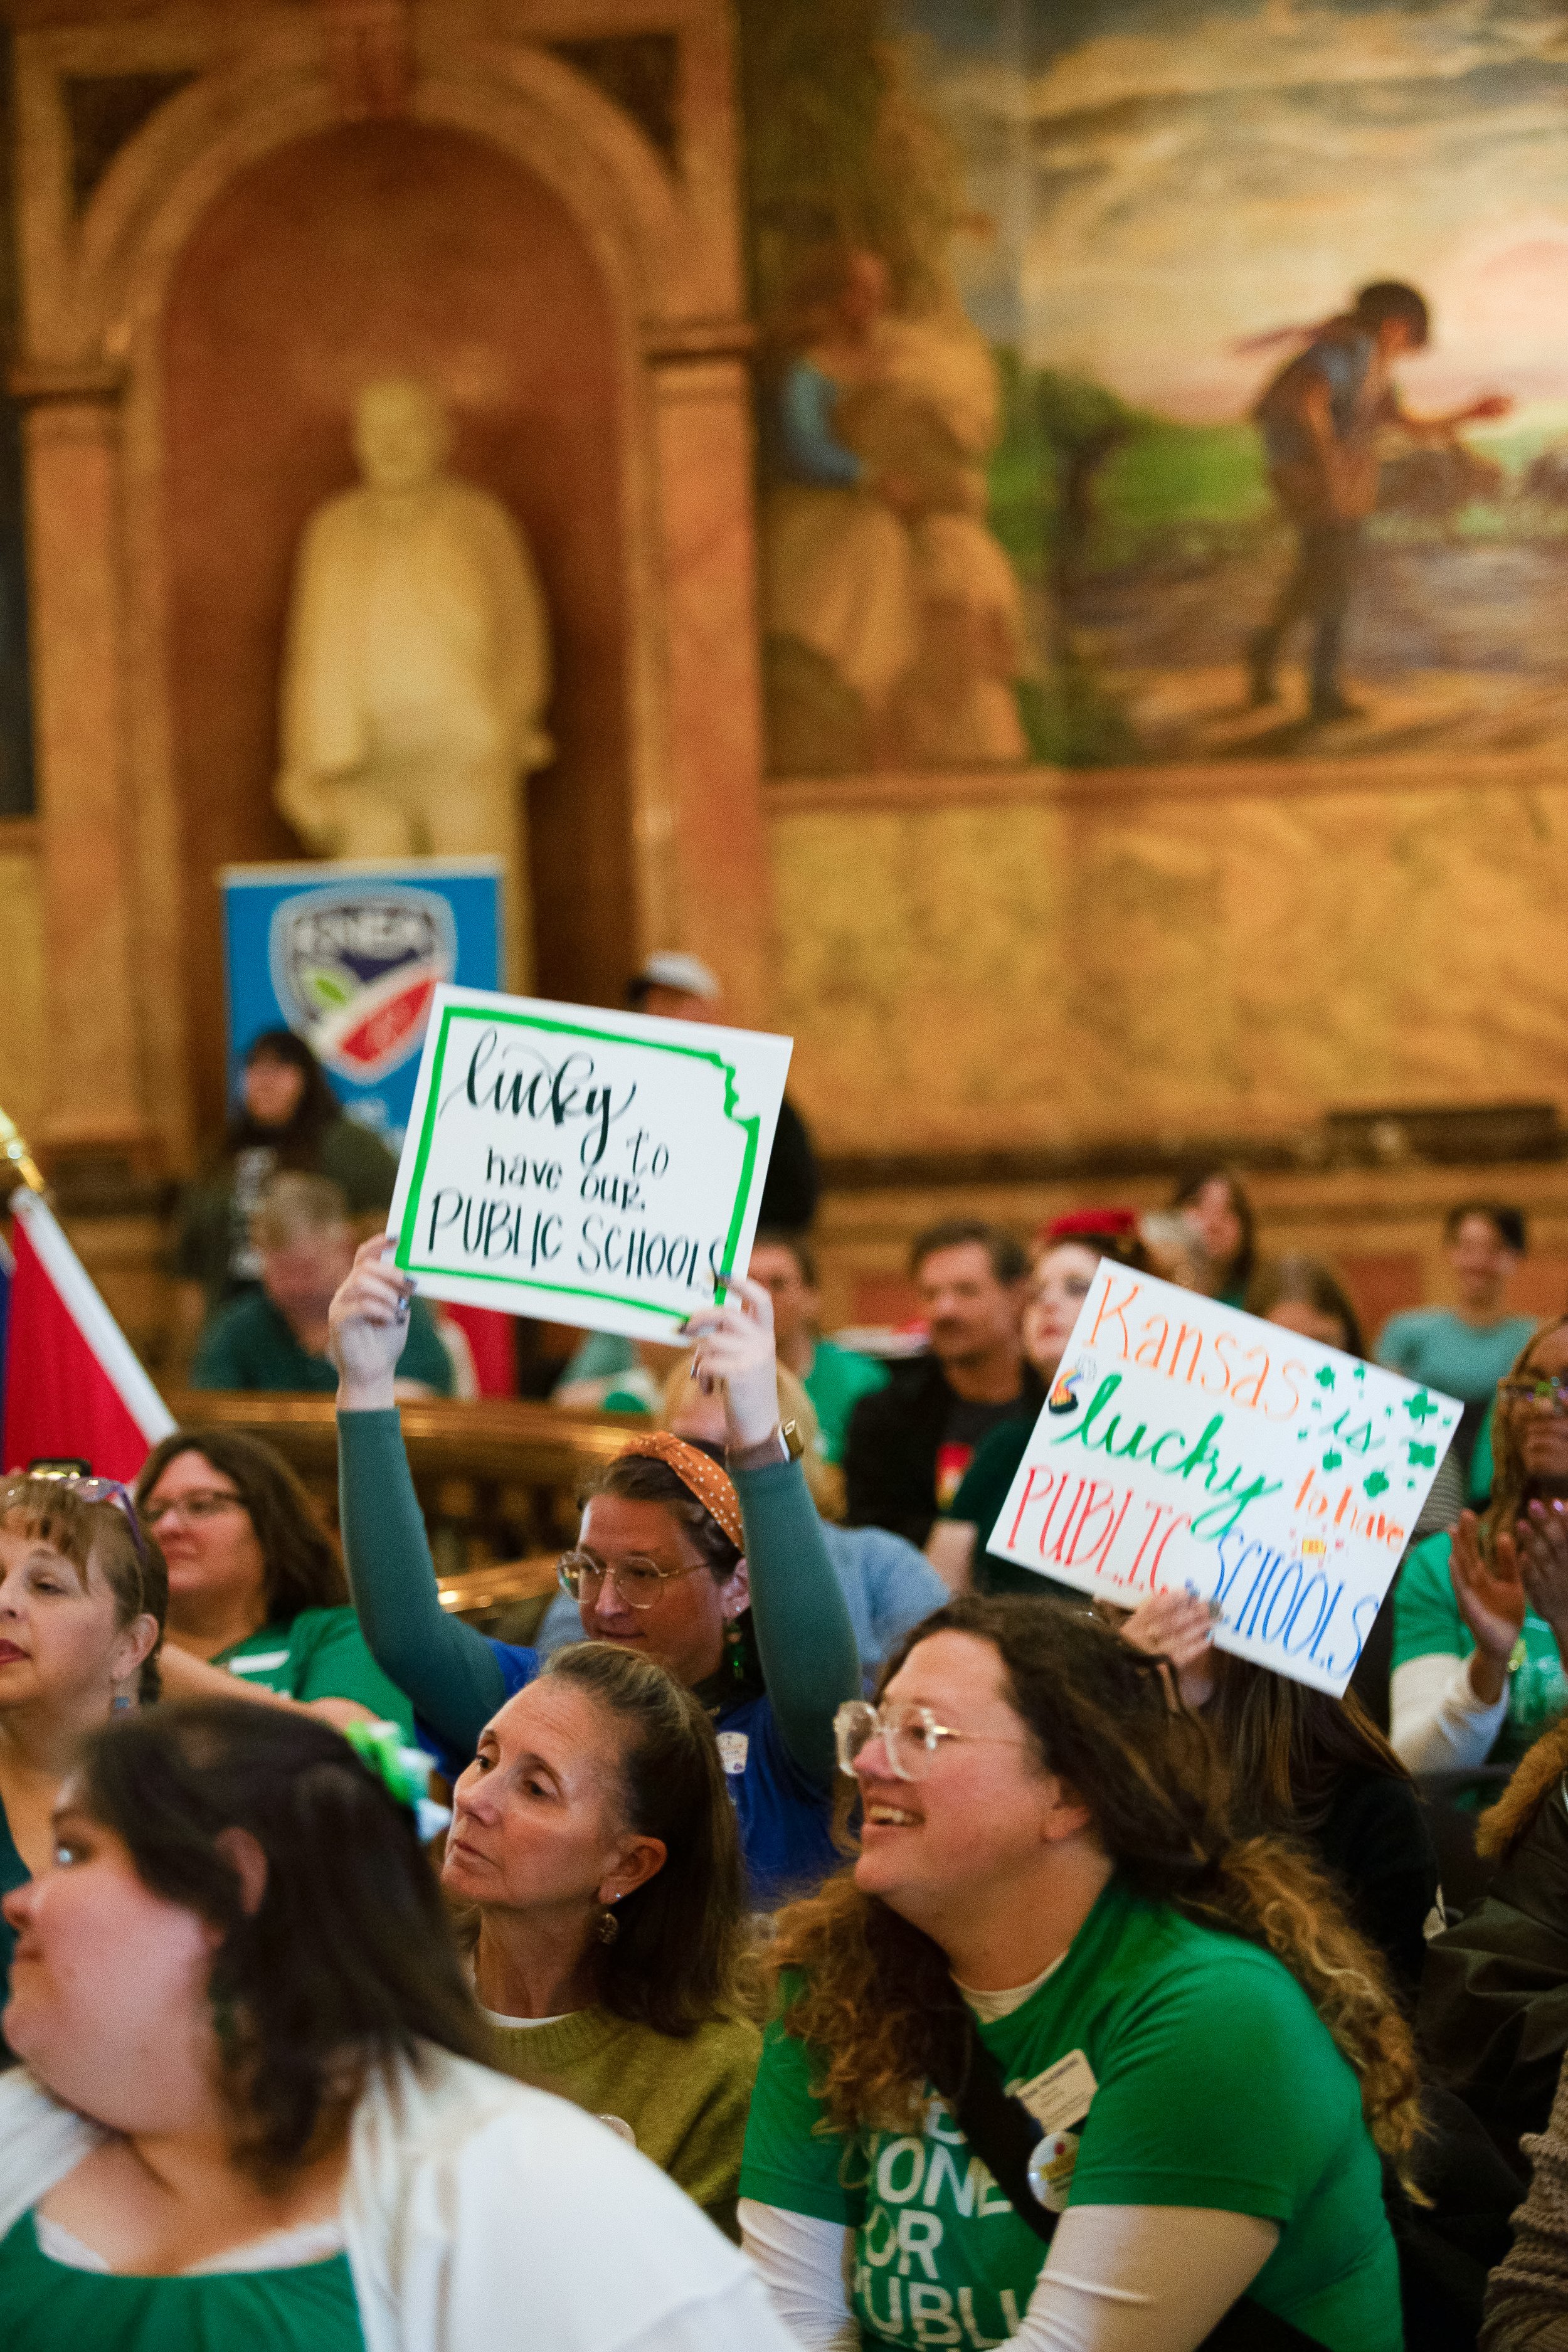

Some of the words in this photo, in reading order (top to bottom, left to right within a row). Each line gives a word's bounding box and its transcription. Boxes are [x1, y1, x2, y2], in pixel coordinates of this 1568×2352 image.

[439, 1026, 637, 1168] lucky
[627, 1125, 669, 1178] to
[485, 1145, 563, 1191] have
[427, 1187, 563, 1269] PUBLIC
[577, 1213, 729, 1298] SCHOOLS
[1082, 1275, 1308, 1421] Kansas
[1318, 1407, 1386, 1458] is
[1050, 1374, 1284, 1542] lucky
[1294, 1466, 1328, 1518] to
[1333, 1485, 1405, 1552] have
[1007, 1465, 1192, 1594] PUBLIC
[1185, 1526, 1380, 1680] SCHOOLS
[864, 2205, 944, 2279] OR
[855, 2265, 1023, 2349] UBLI
